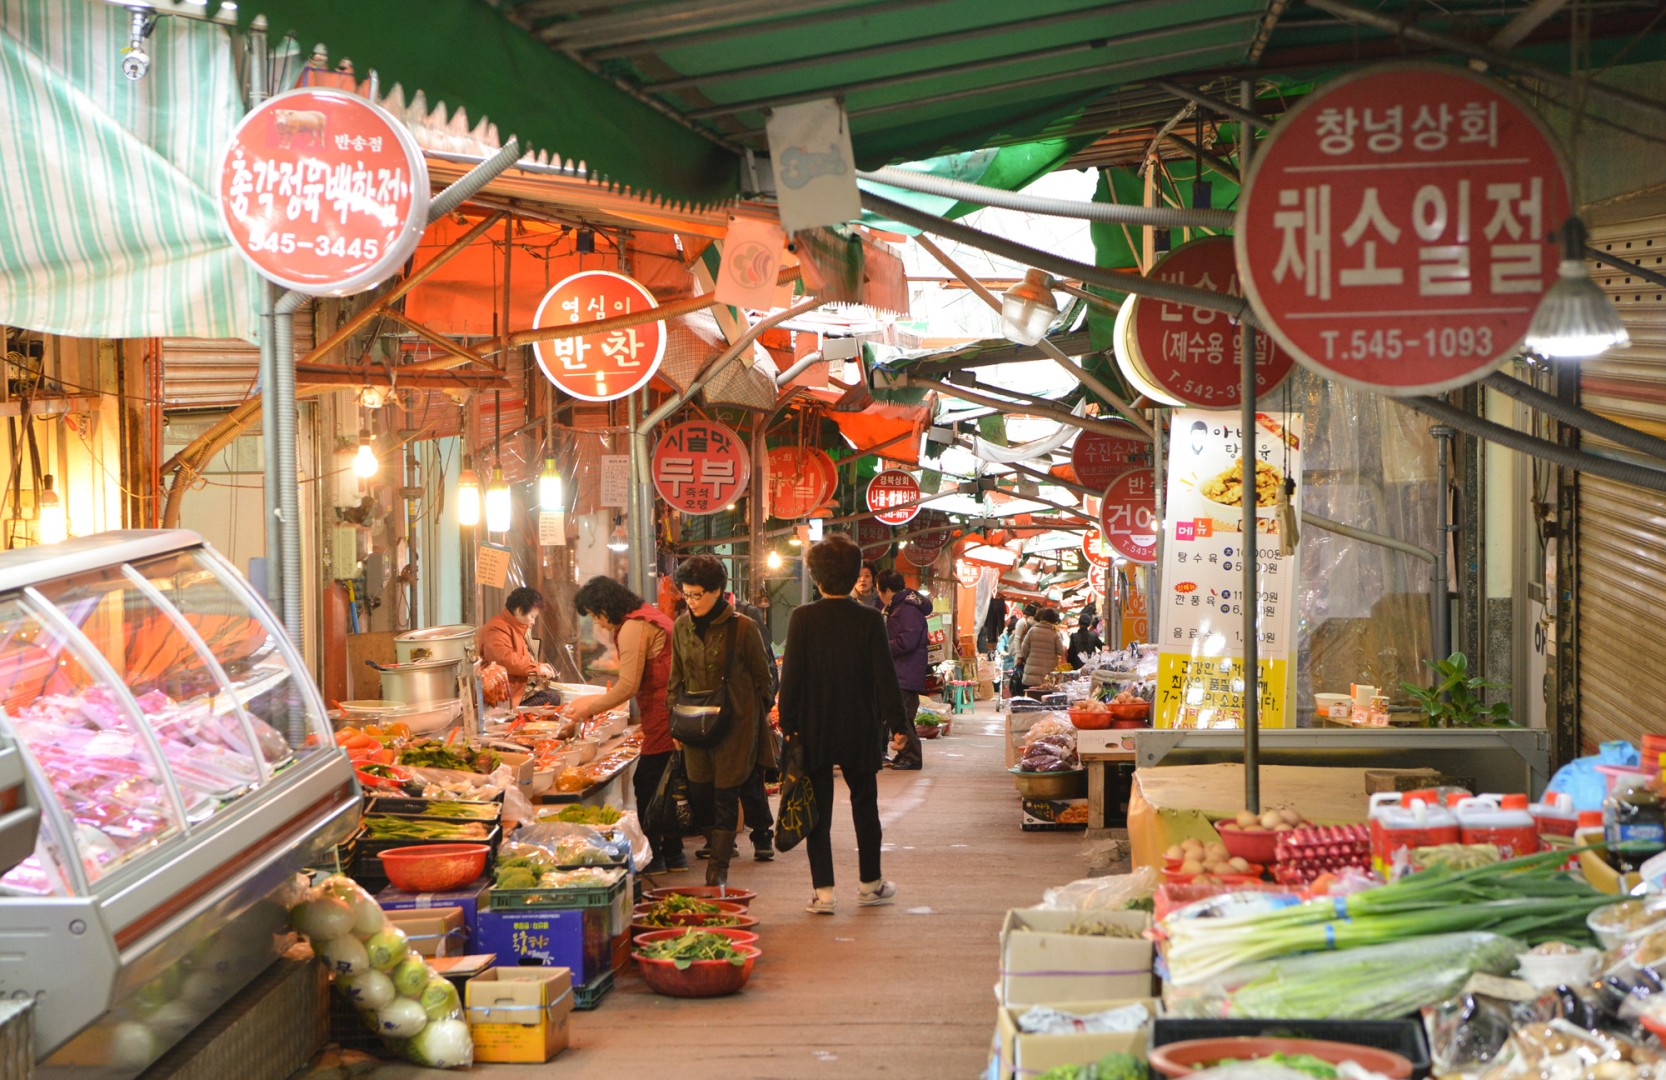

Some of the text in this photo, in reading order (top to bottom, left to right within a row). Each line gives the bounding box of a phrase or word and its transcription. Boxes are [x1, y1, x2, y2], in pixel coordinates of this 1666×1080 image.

[335, 134, 383, 152] 반송점
[1316, 101, 1498, 155] 창녕상회
[1272, 177, 1543, 300] 채소일절
[561, 295, 631, 322] 영심이
[553, 328, 645, 369] 반찬
[1320, 326, 1493, 360] T.545-1093
[665, 428, 731, 453] 시골맛
[1225, 443, 1271, 460] 탕육
[659, 458, 735, 499] 두부
[1178, 520, 1207, 535] 메뉴
